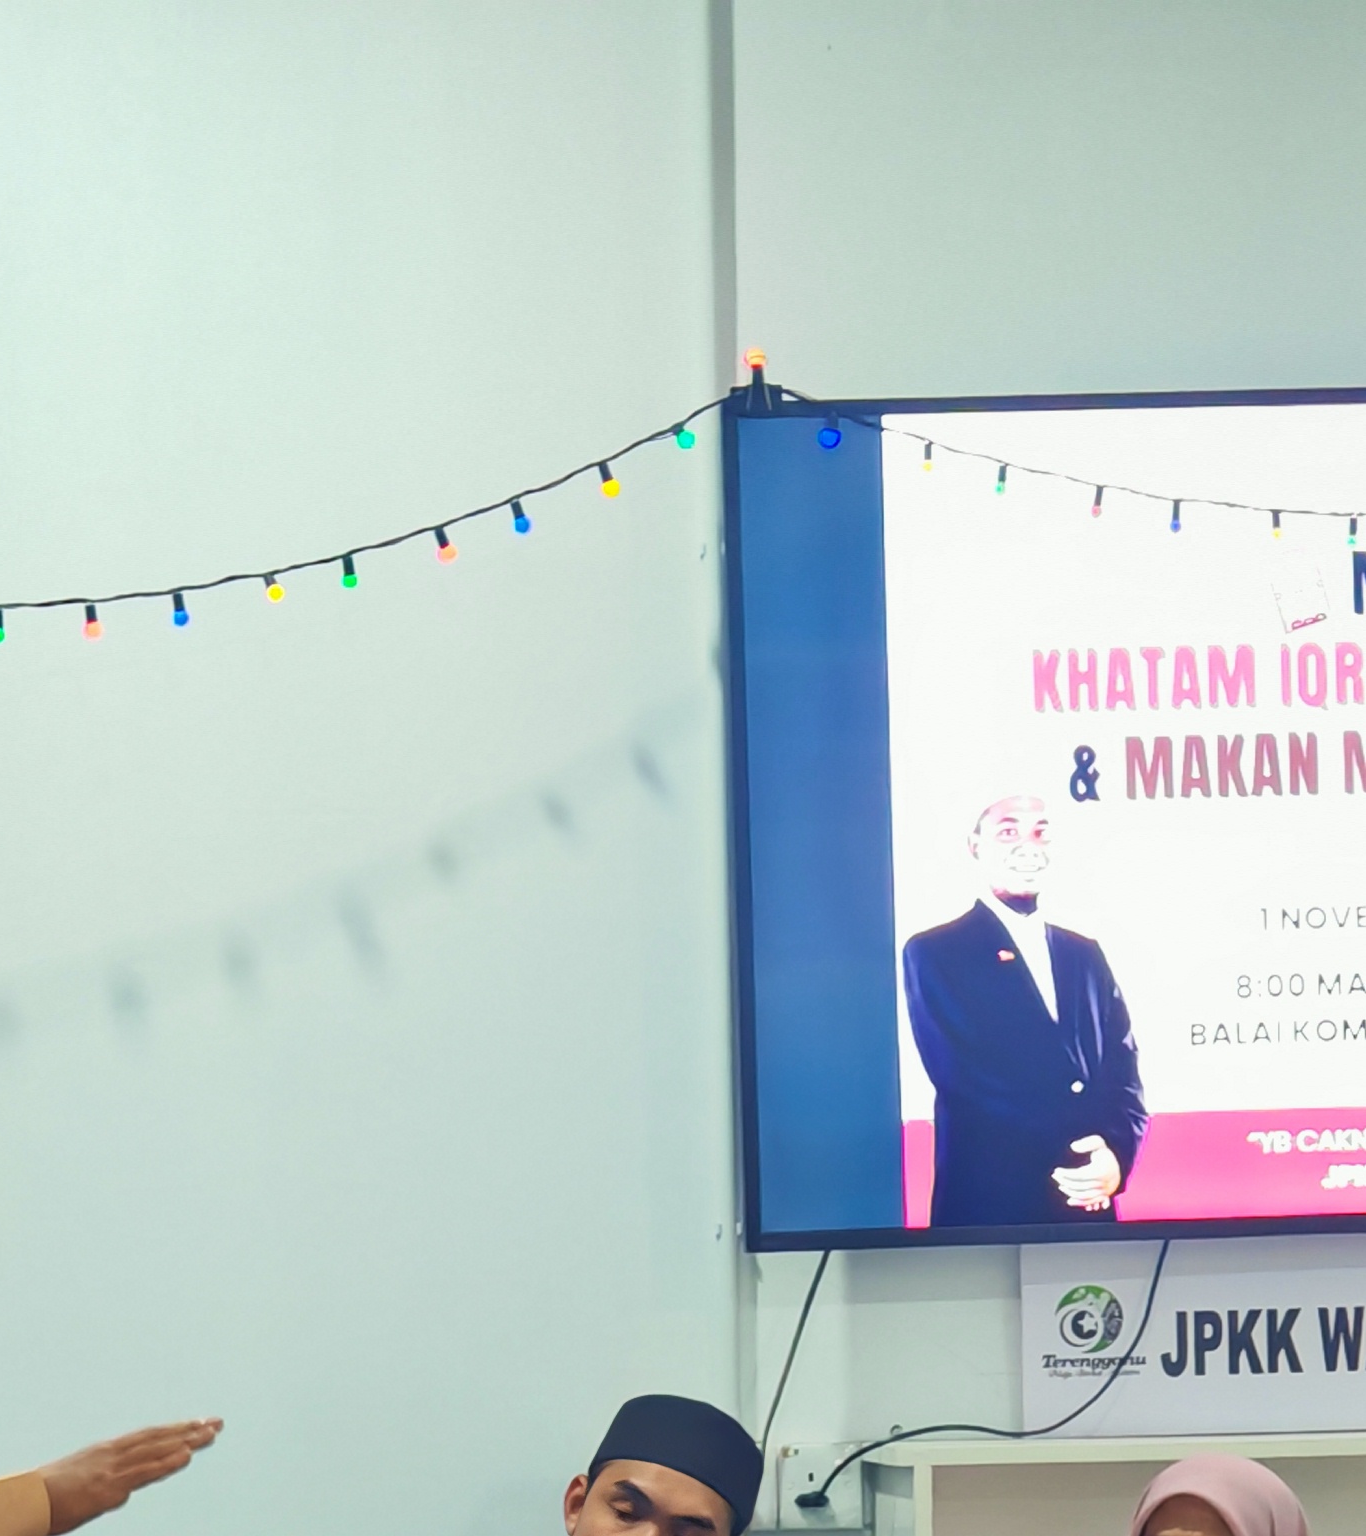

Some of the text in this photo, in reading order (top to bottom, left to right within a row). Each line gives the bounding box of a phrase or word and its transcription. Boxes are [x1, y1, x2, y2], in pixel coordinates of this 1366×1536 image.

[1032, 643, 1257, 713] KHATAM
[1069, 745, 1101, 803] &
[1124, 731, 1319, 801] MAKAN
[1260, 907, 1268, 931] 1
[1236, 973, 1306, 999] 8:00
[1190, 1020, 1281, 1046] BALAI
[1160, 1308, 1304, 1377] JPKK
